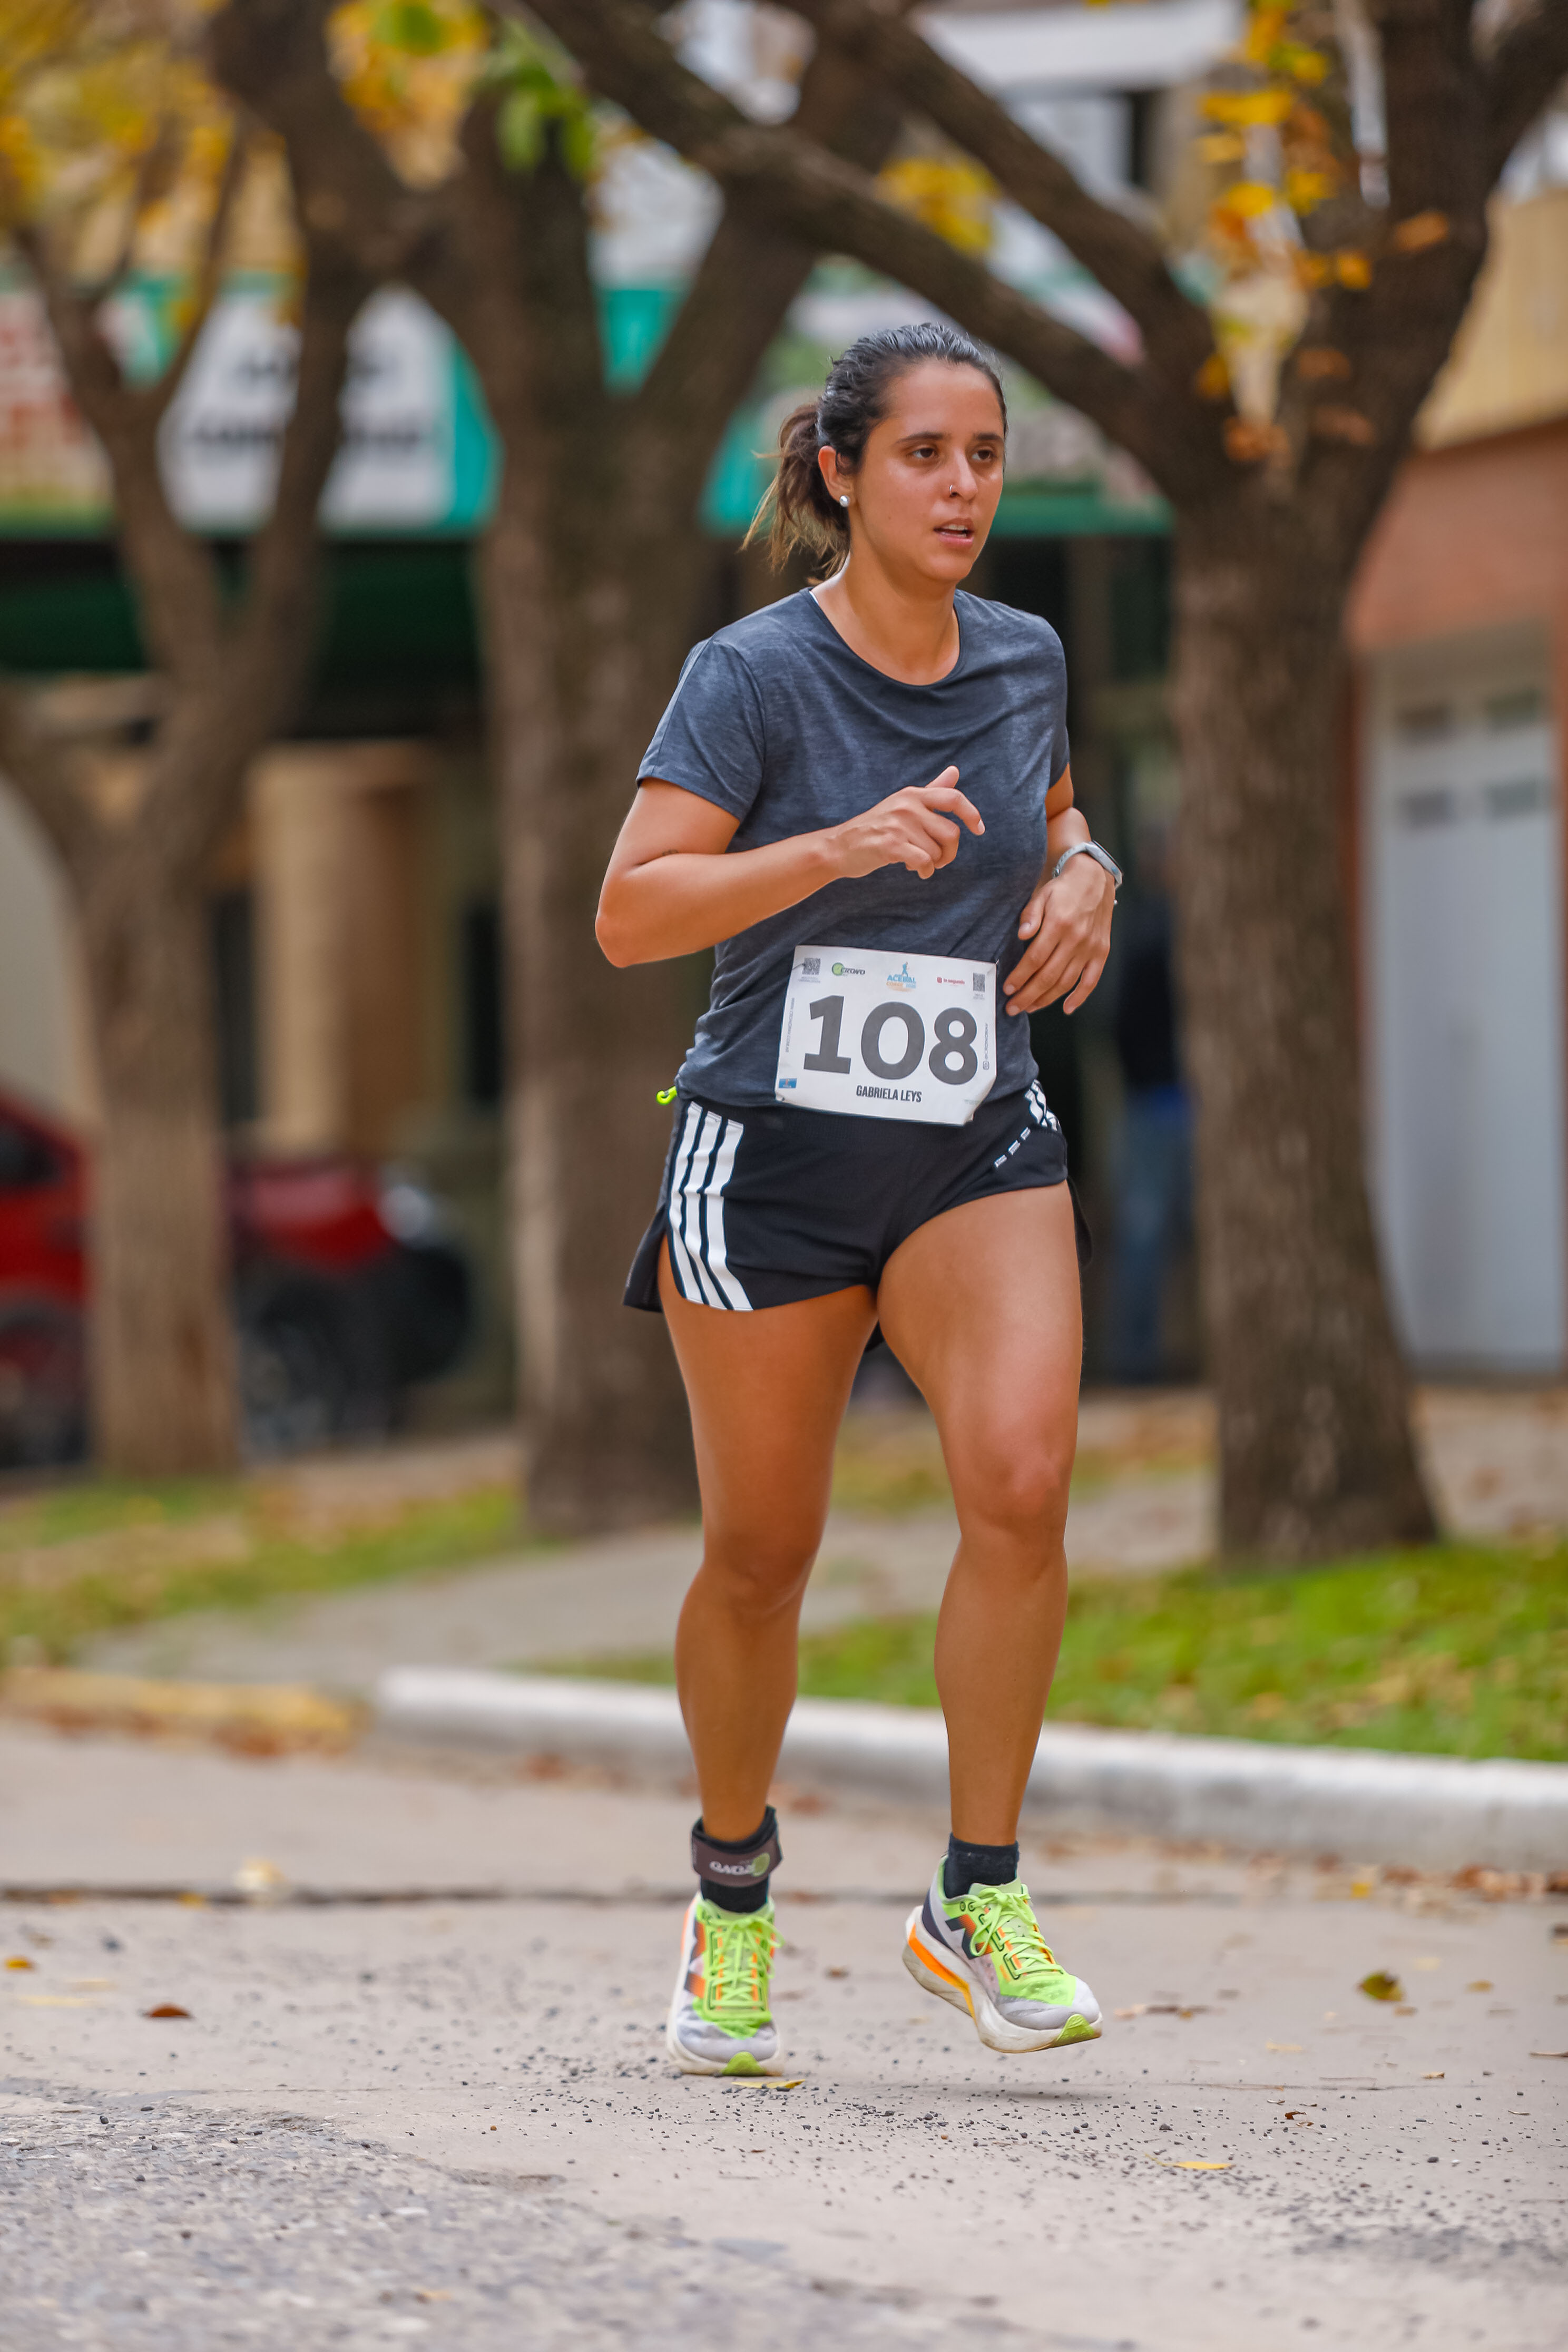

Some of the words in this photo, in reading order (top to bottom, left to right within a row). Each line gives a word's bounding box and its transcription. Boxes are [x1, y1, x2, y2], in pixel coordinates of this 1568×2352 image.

[803, 995, 978, 1085] 108
[856, 1085, 898, 1101] GABRIELA
[900, 1090, 922, 1102] LEYS
